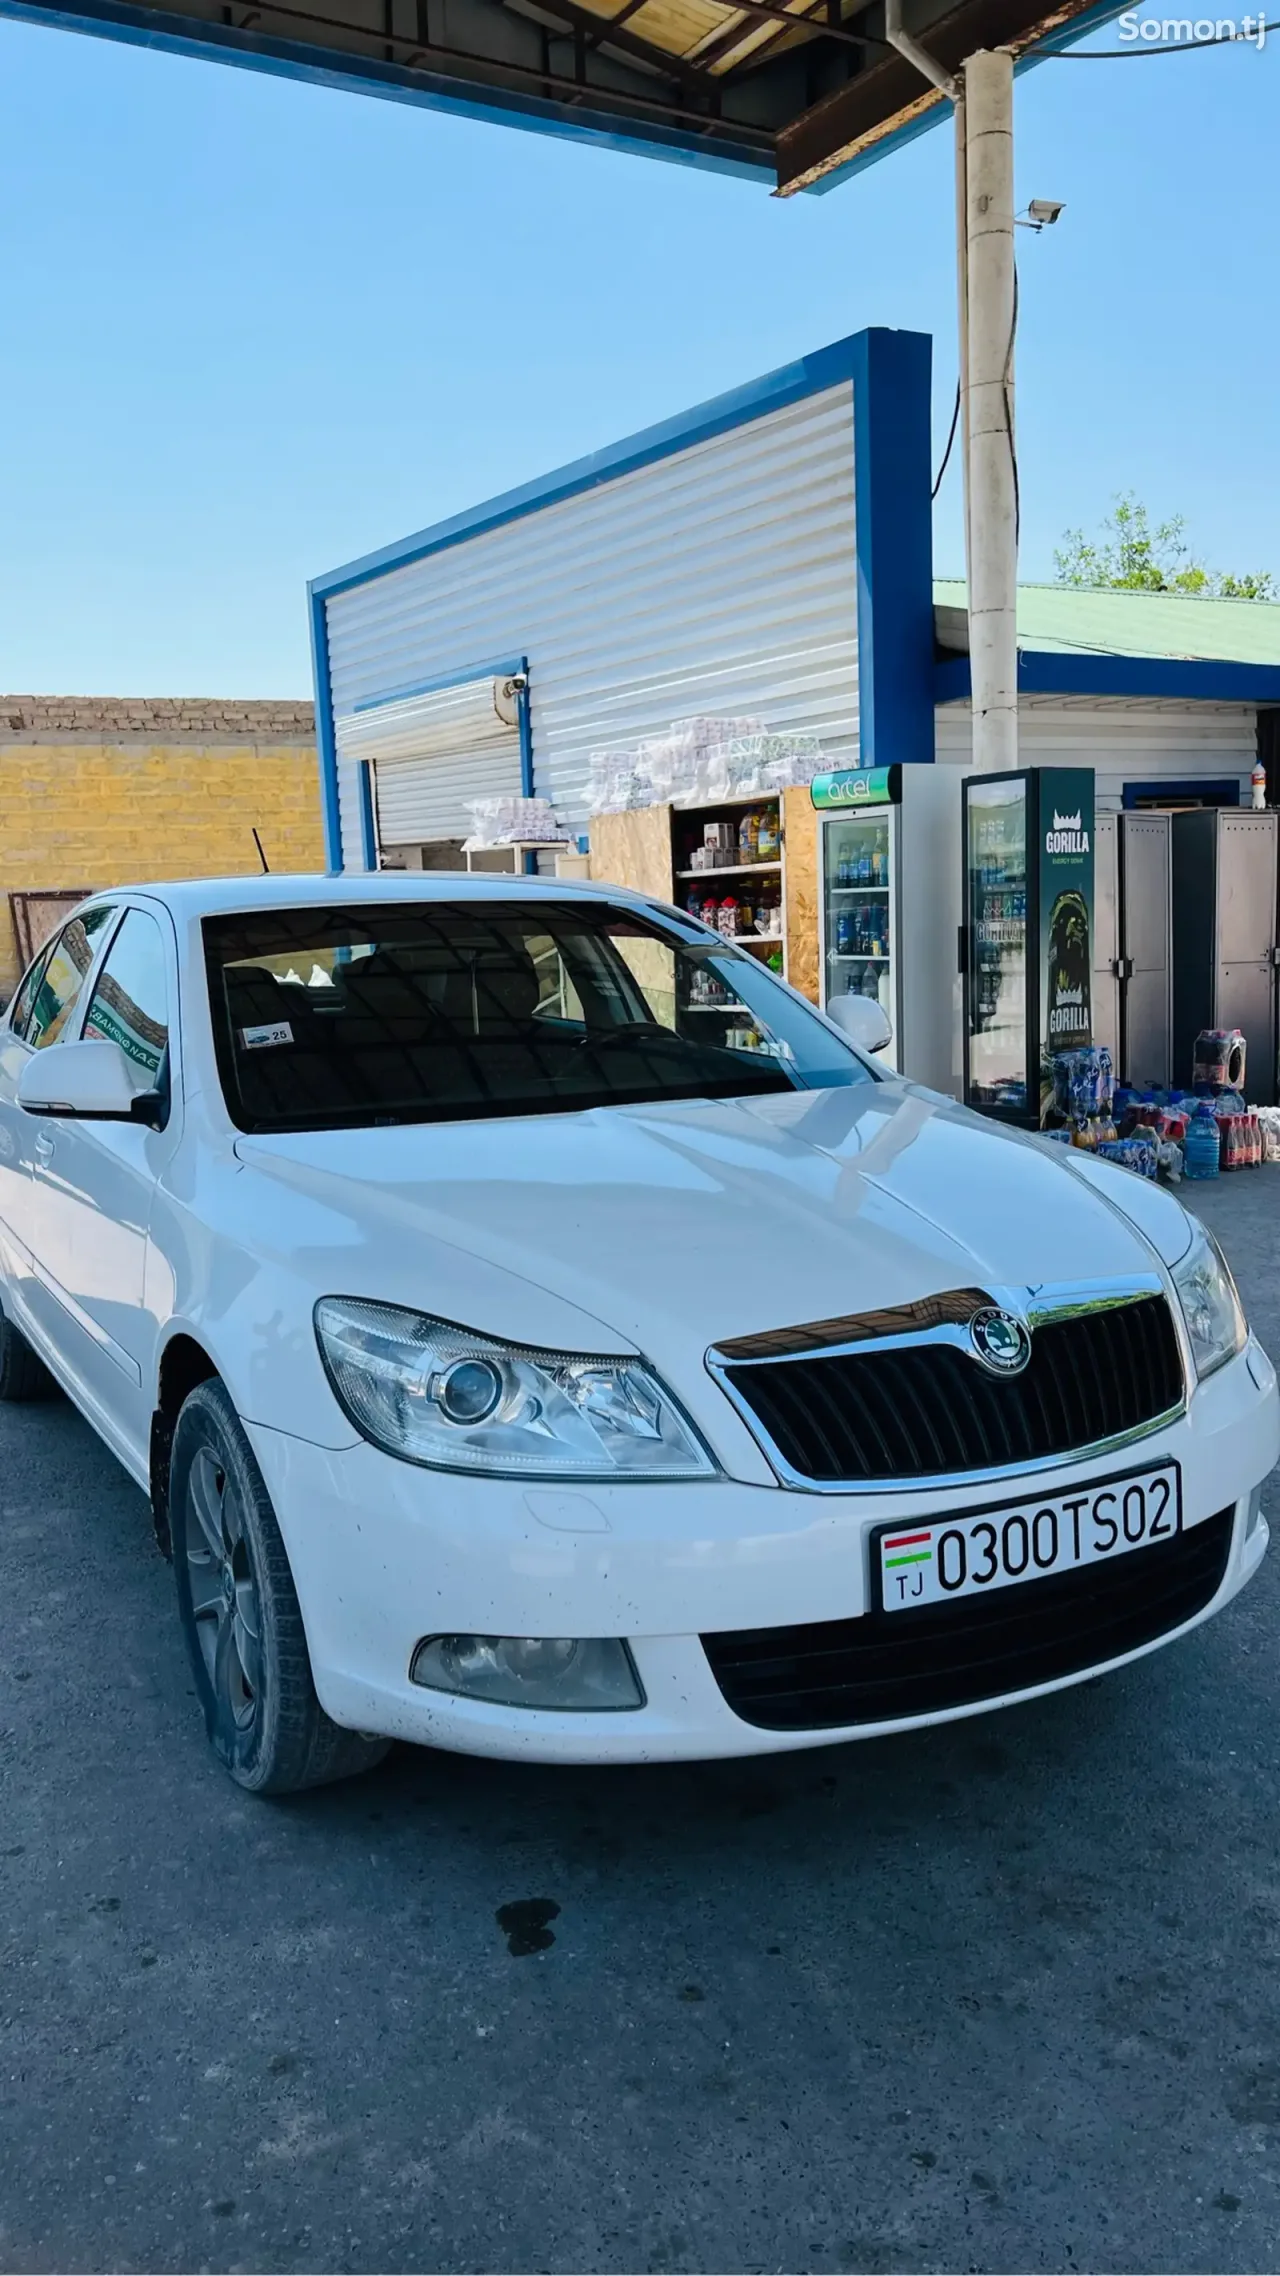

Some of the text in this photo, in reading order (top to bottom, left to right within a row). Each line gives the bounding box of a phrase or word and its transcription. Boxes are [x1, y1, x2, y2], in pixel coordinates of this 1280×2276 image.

[828, 772, 870, 800] artel
[1046, 831, 1090, 853] GORILLA
[1050, 1007, 1089, 1033] GORILLA
[272, 1030, 288, 1041] 25
[896, 1478, 1172, 1600] TJ 0300TS02
